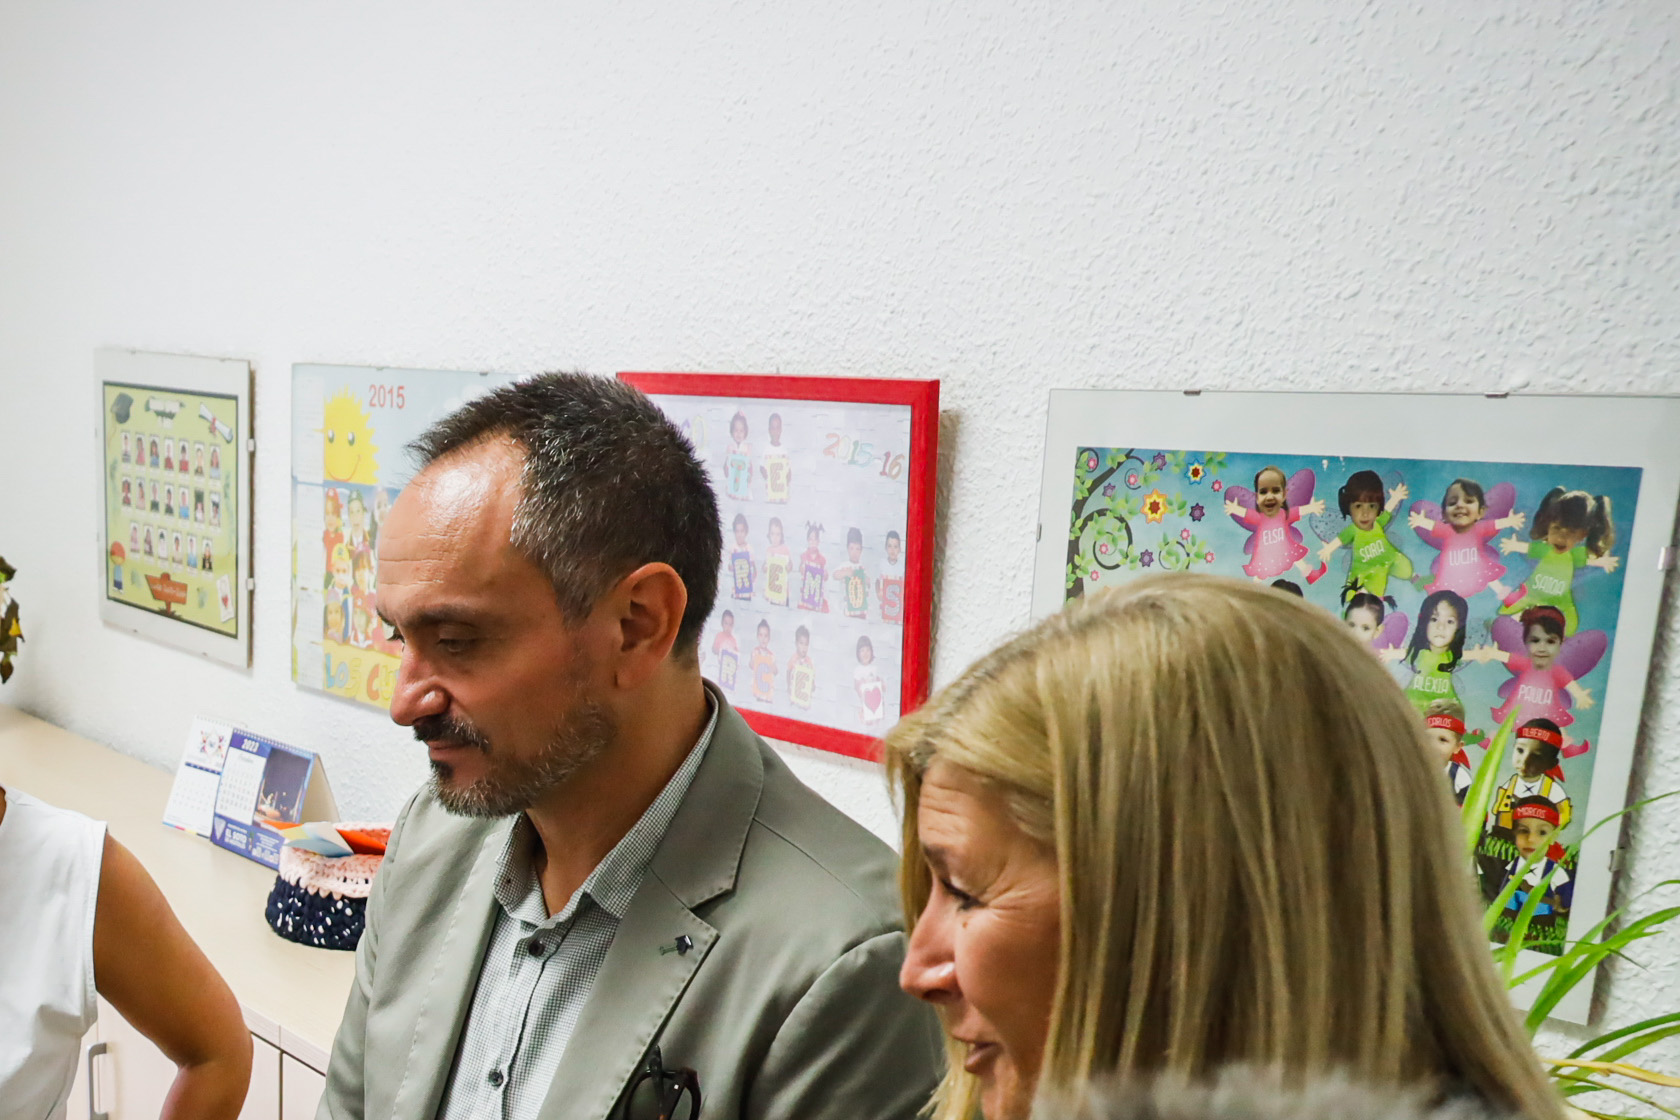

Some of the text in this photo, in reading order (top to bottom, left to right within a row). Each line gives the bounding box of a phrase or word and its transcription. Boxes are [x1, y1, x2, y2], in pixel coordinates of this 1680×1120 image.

[368, 384, 406, 409] 2015
[823, 433, 905, 480] 2015-16
[1262, 527, 1285, 545] ELSA
[1359, 539, 1385, 563] SARA
[366, 662, 401, 702] CU
[1413, 675, 1451, 694] ALEXIA
[1518, 684, 1554, 705] PAULA
[1427, 717, 1453, 728] CARLOS
[1522, 728, 1551, 740] ALBERTO
[1517, 807, 1547, 819] MARCOS
